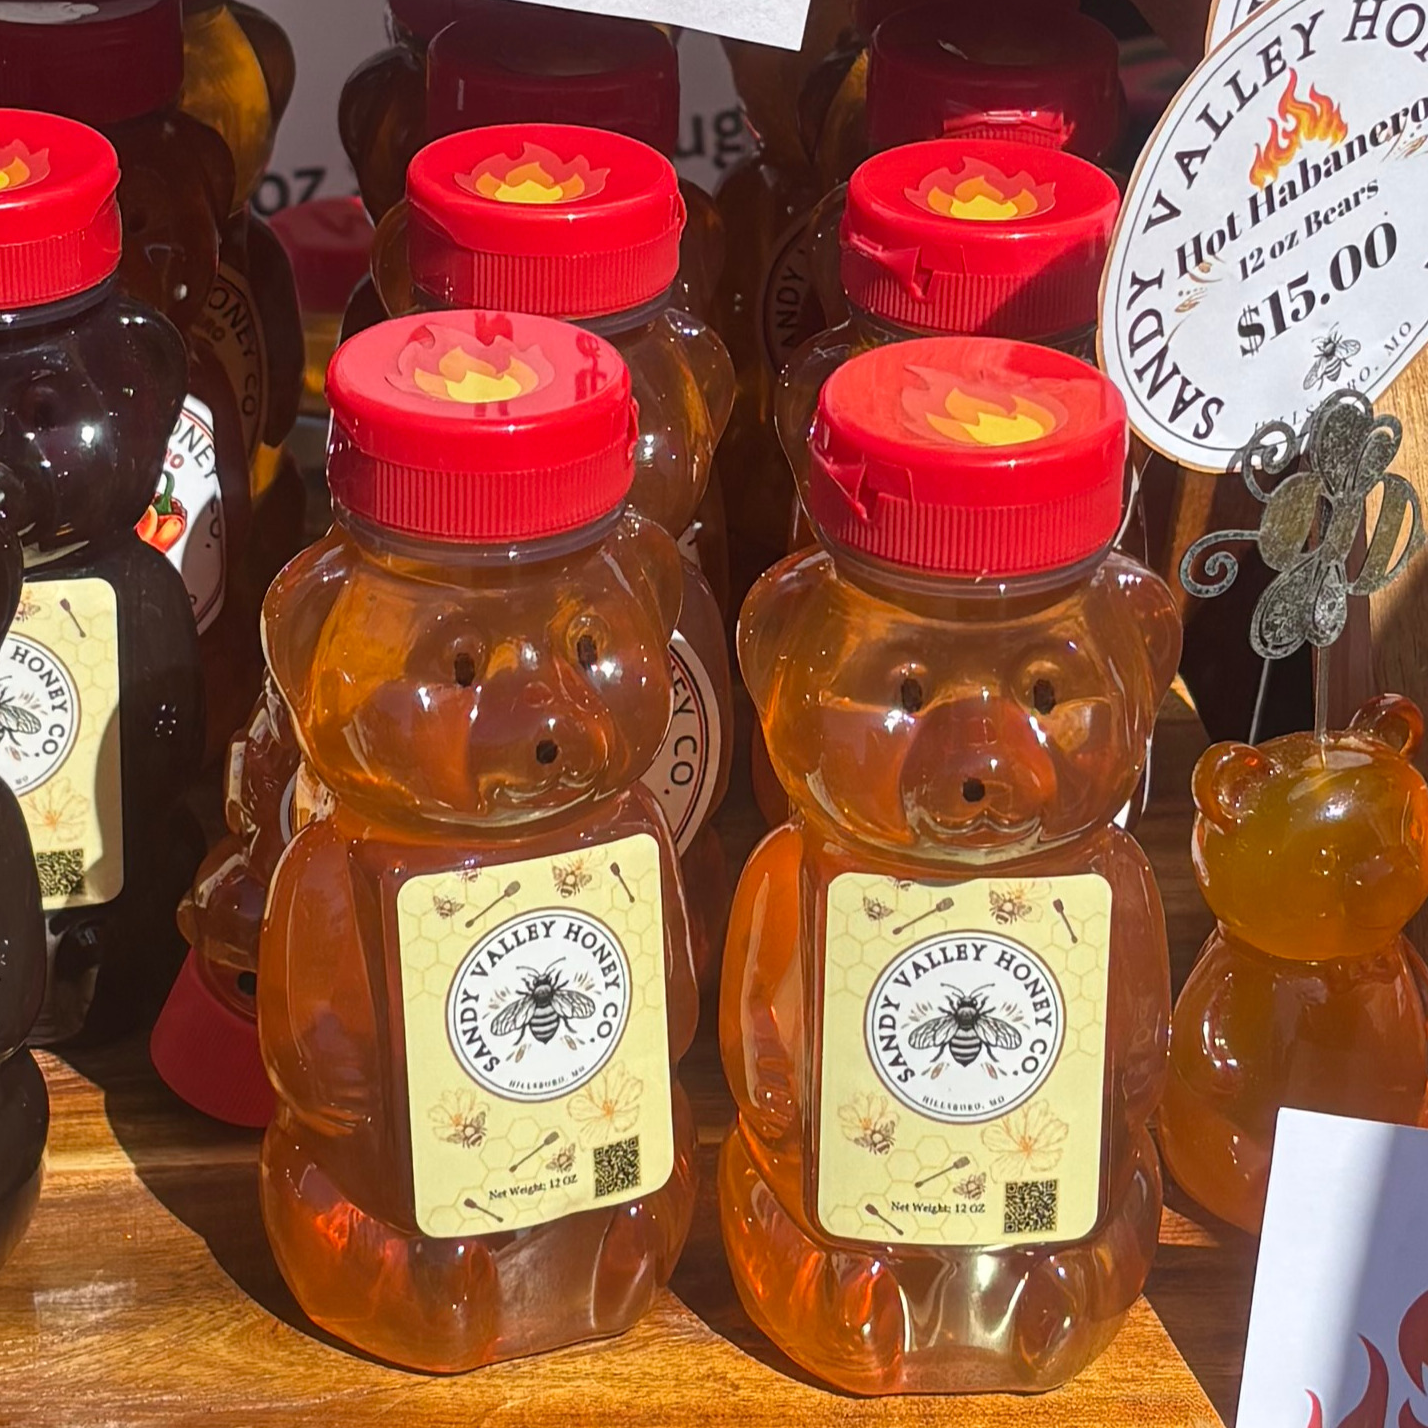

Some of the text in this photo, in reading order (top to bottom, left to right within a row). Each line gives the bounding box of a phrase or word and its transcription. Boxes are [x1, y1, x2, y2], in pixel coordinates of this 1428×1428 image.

[1143, 9, 1326, 236] VALLEY
[1175, 211, 1242, 278] Hot
[1237, 178, 1380, 282] 12 oz Bears
[1235, 220, 1399, 358] $15.00
[1128, 268, 1226, 442] SANDY
[1384, 320, 1413, 357] MO
[9, 644, 70, 714] HONEY
[469, 919, 558, 979] VALLEY
[562, 922, 622, 992] HONEY
[893, 943, 989, 989] VALLEY
[994, 949, 1053, 1028] HONEY
[459, 989, 501, 1075] SANDY
[878, 999, 917, 1084] SANDY
[549, 1176, 561, 1189] 12
[562, 1172, 579, 1186] OZ
[890, 1200, 986, 1215] Net Weight: 12 OZ
